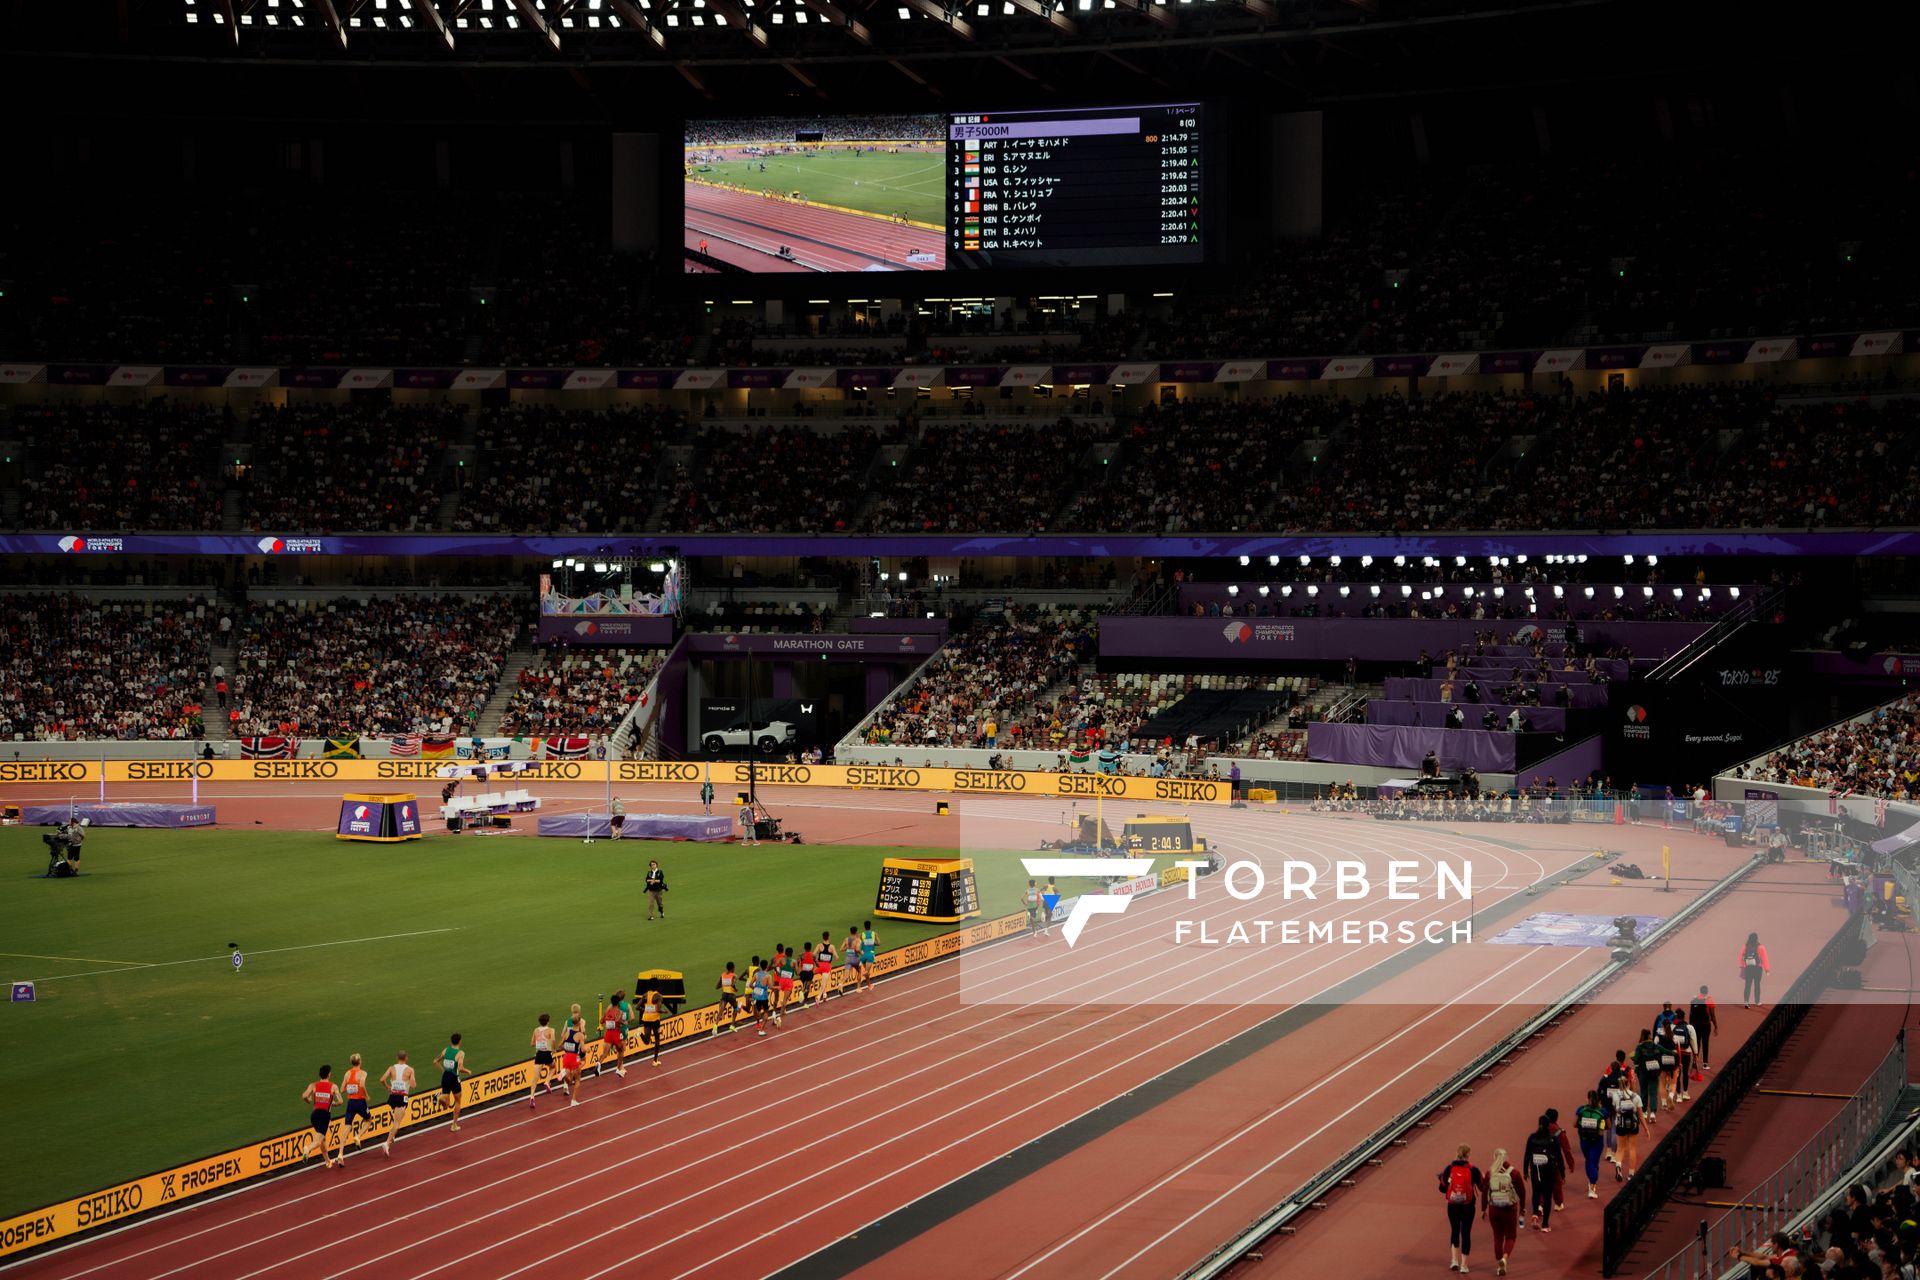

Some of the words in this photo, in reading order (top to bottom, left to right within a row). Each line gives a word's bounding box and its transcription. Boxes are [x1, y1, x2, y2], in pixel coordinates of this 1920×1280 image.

[955, 126, 1009, 138] 男子5000M
[1161, 134, 1188, 142] 2:14.79
[1161, 146, 1188, 154] 2:15.05
[1161, 159, 1188, 167] 2:19.40
[1161, 184, 1188, 192] 2:20.03
[1161, 197, 1188, 205] 2:20.24
[1161, 235, 1188, 243] 2:20.79
[773, 640, 832, 649] MARATHON
[837, 640, 864, 649] GATE
[0, 763, 86, 781] SEIKO
[128, 762, 214, 779] SEIKO
[254, 762, 339, 779] SEIKO
[619, 764, 699, 780] SEIKO
[735, 765, 811, 783] SEIKO
[846, 768, 920, 786] SEIKO
[954, 771, 1026, 791] SEIKO
[1058, 775, 1126, 796] SEIKO
[1156, 780, 1217, 801] SEIKO
[971, 925, 992, 943] SEIKO
[904, 943, 928, 964] SEIKO
[872, 955, 898, 973] PROSPEX
[484, 1069, 527, 1096] PROSPEX
[182, 1156, 241, 1192] PROSPEX
[77, 1184, 142, 1227] SEIKO
